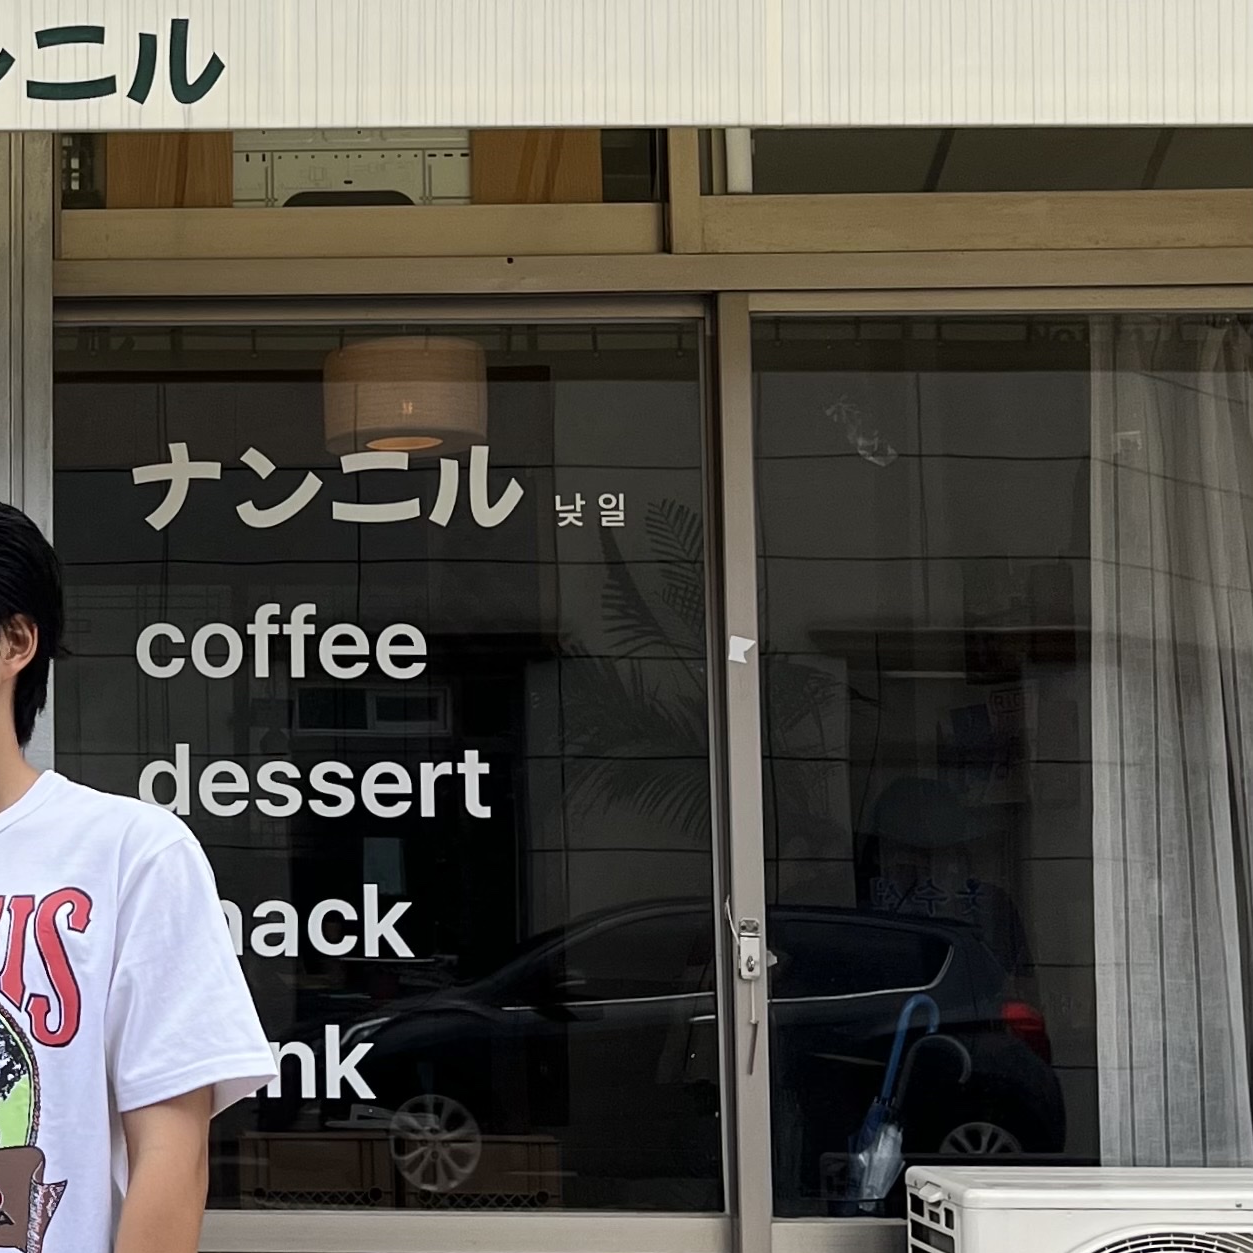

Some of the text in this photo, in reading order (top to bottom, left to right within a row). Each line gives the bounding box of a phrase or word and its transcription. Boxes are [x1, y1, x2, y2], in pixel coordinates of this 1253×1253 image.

[132, 442, 525, 531] ナンニル
[135, 603, 428, 679] coffee
[138, 743, 491, 819] dessert
[220, 883, 416, 958] ack
